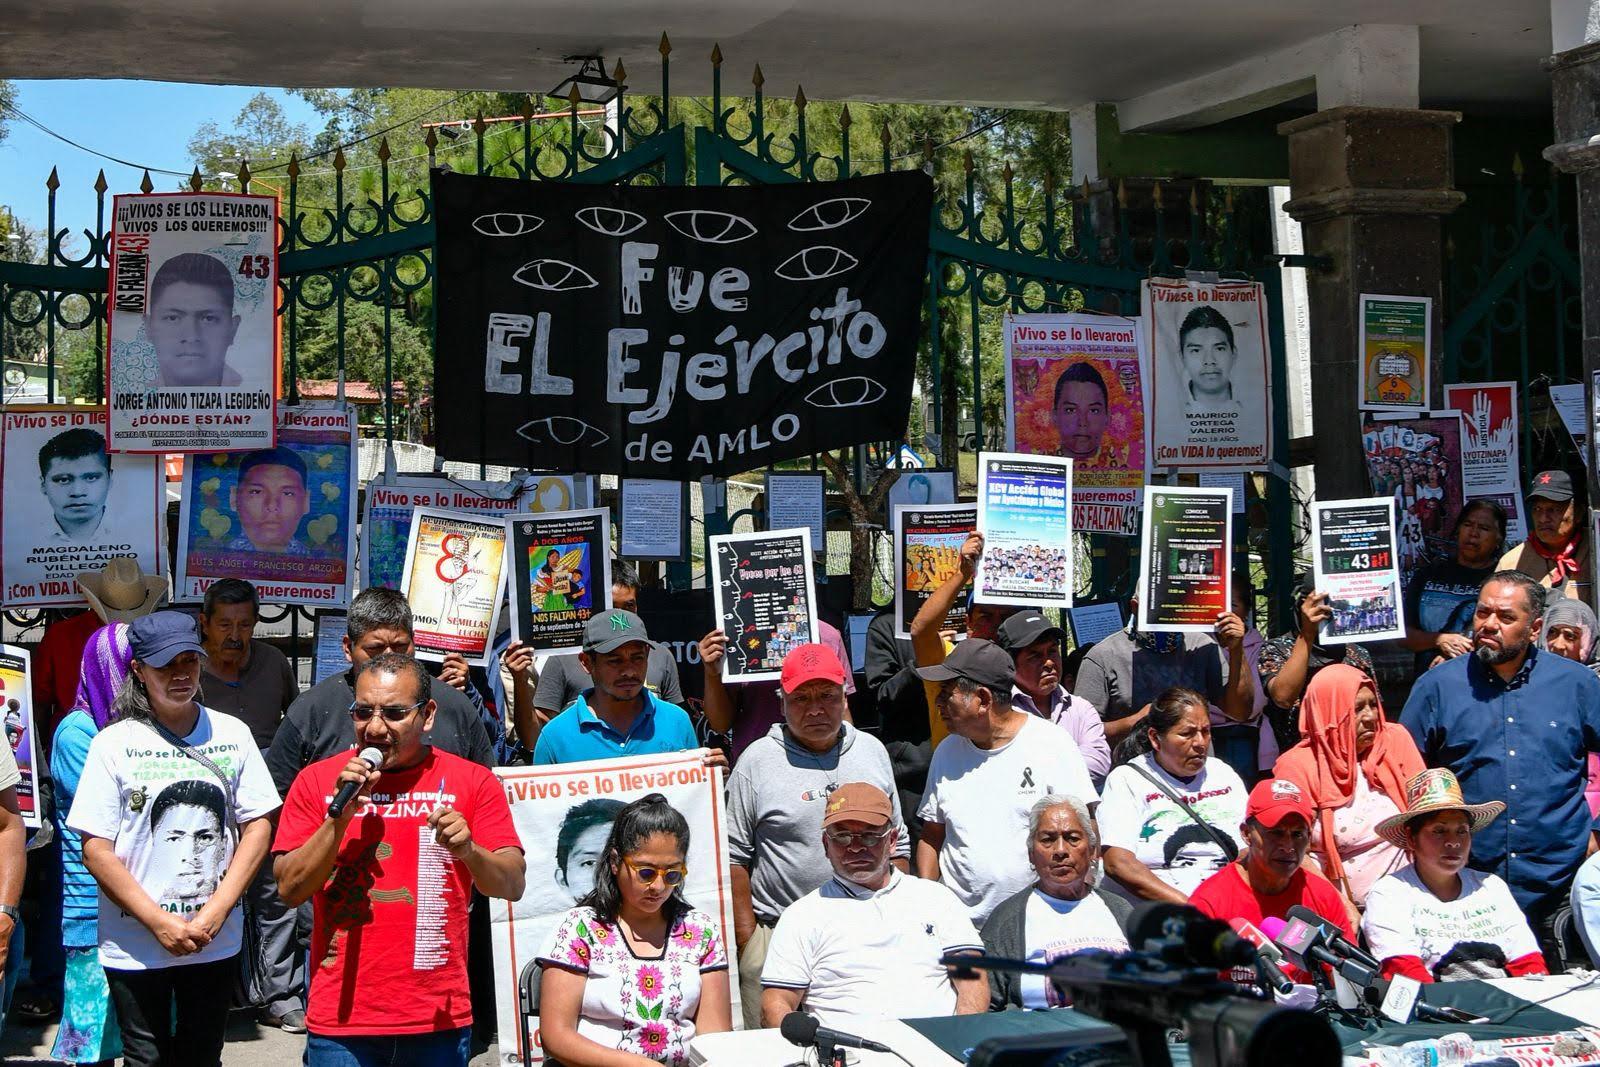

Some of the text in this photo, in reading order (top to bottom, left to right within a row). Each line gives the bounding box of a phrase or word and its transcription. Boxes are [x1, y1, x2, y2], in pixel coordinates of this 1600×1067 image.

[118, 202, 272, 221] ¡¡¡VIVOS SE LOS LLEVARON,
[123, 221, 267, 232] VIVOS LOS QUEREMOS!!!
[118, 254, 147, 291] FALTAN
[239, 255, 270, 279] 43
[622, 242, 751, 316] Fue
[1197, 289, 1208, 301] lo
[1014, 327, 1135, 343] ¡Vivo se lo llevaron!
[485, 287, 888, 425] EL Ejército
[1391, 378, 1398, 388] 6
[113, 389, 271, 410] JORGE ANTONIO TIZAPA LEGIDEÑO
[1382, 390, 1406, 401] años
[8, 414, 46, 430] ¡Vivo
[51, 415, 66, 428] se
[71, 413, 84, 426] lo
[132, 413, 251, 427] ¿DÓNDE ESTÁN?
[284, 412, 349, 427] llevaron!
[115, 431, 139, 439] CONTRA
[140, 431, 148, 439] EL
[625, 413, 800, 463] de AMLO
[1480, 414, 1488, 448] JUSTICIA
[152, 439, 188, 447] AYOTZINAPA
[1157, 445, 1263, 460] ¡Con VIDA lo queremos!
[373, 490, 518, 509] ¡Vivo se lo llevaron!
[1040, 486, 1065, 499] Global
[1072, 505, 1085, 529] OS
[1087, 506, 1122, 530] FALTAN
[1402, 522, 1421, 544] 43
[33, 544, 132, 555] MAGDALENO
[27, 555, 80, 564] RUBÉN
[44, 562, 108, 572] VILLEGA
[191, 557, 214, 567] LUIS
[253, 558, 304, 571] FRANCISCO
[309, 562, 344, 573] ARZOLA
[1351, 553, 1370, 569] 43
[8, 584, 35, 600] ¡Con
[39, 581, 71, 597] VIDA
[259, 585, 337, 600] queremos!
[1424, 580, 1450, 592] Sarah
[411, 613, 489, 629] OMOS SEMILLAS
[533, 613, 548, 623] NOS
[549, 611, 577, 621] FALTAN
[547, 622, 573, 632] septiembre
[126, 747, 152, 758] Vivo
[507, 763, 708, 805] ¡Vivo se lo llevaron!
[181, 902, 192, 913] lo
